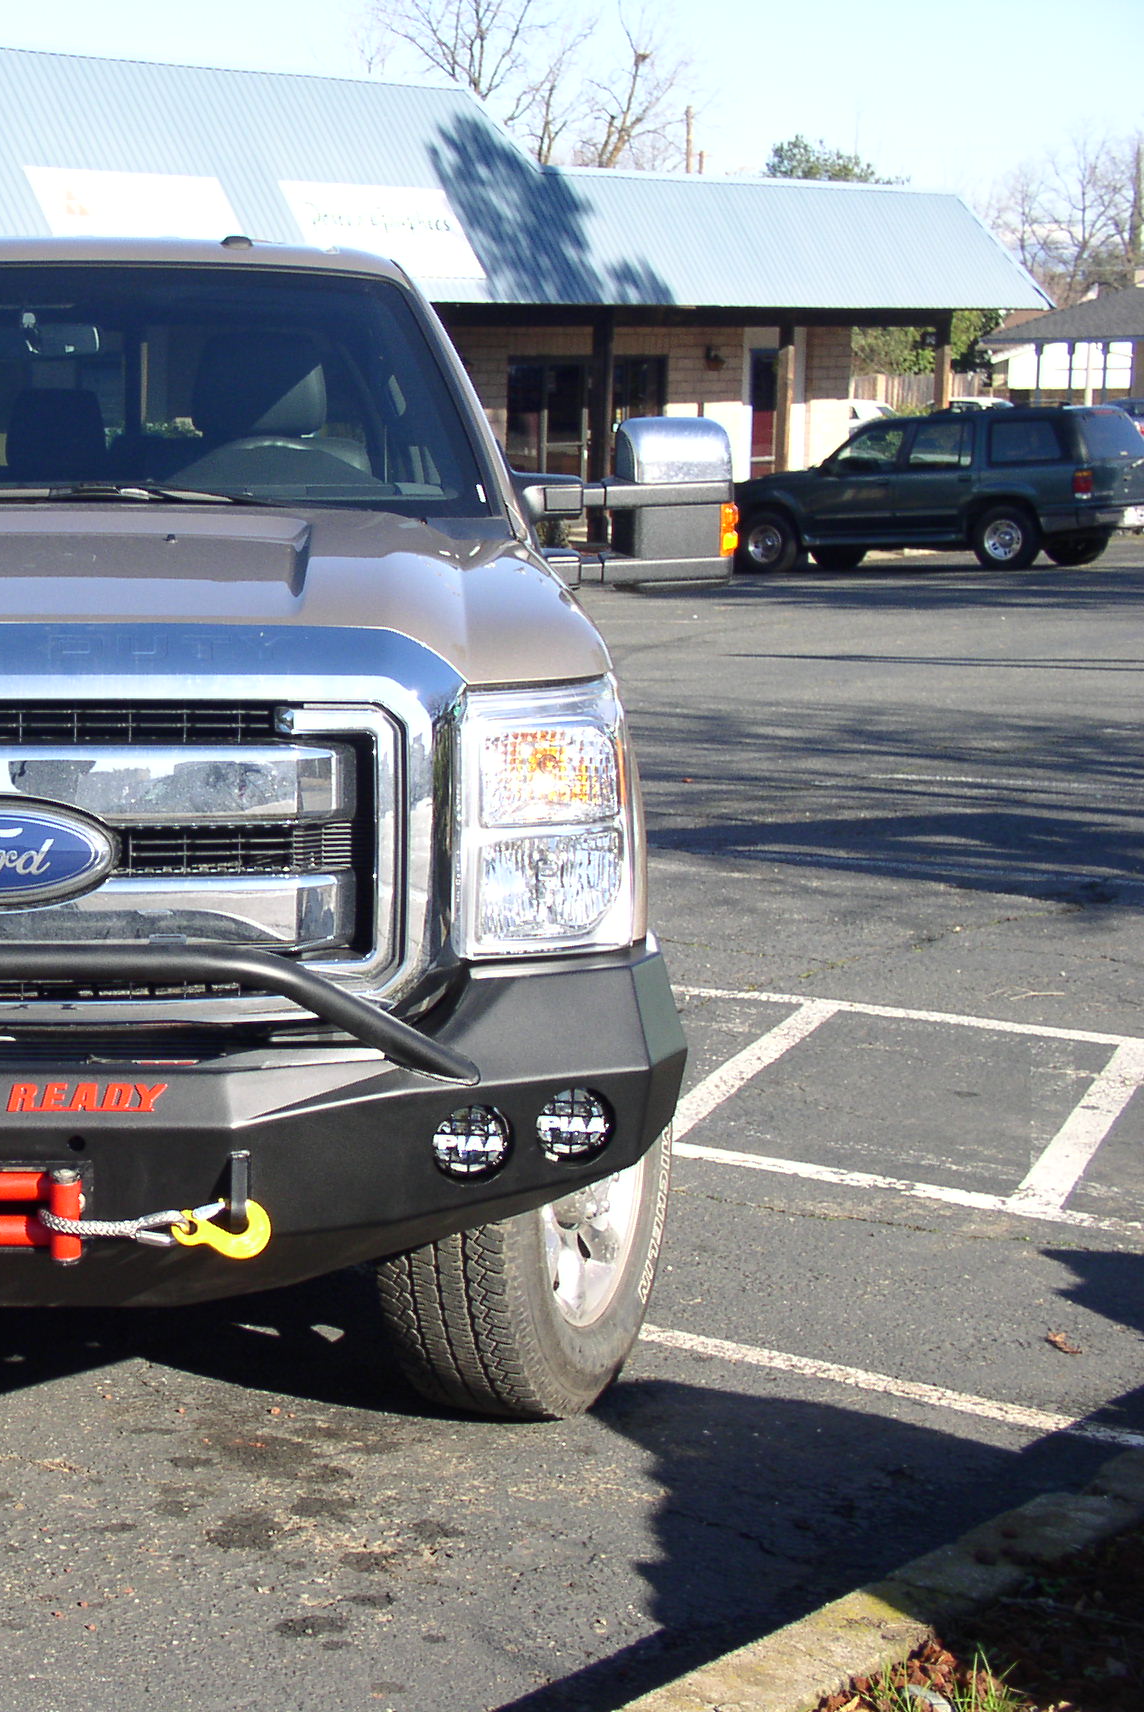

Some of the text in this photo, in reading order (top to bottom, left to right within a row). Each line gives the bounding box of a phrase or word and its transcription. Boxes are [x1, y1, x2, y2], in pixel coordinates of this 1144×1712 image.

[47, 633, 295, 660] DUTY
[6, 1083, 169, 1113] READY
[538, 1115, 607, 1133] PIAA
[434, 1133, 504, 1152] PIAA
[637, 1124, 671, 1304] MICHELIN
